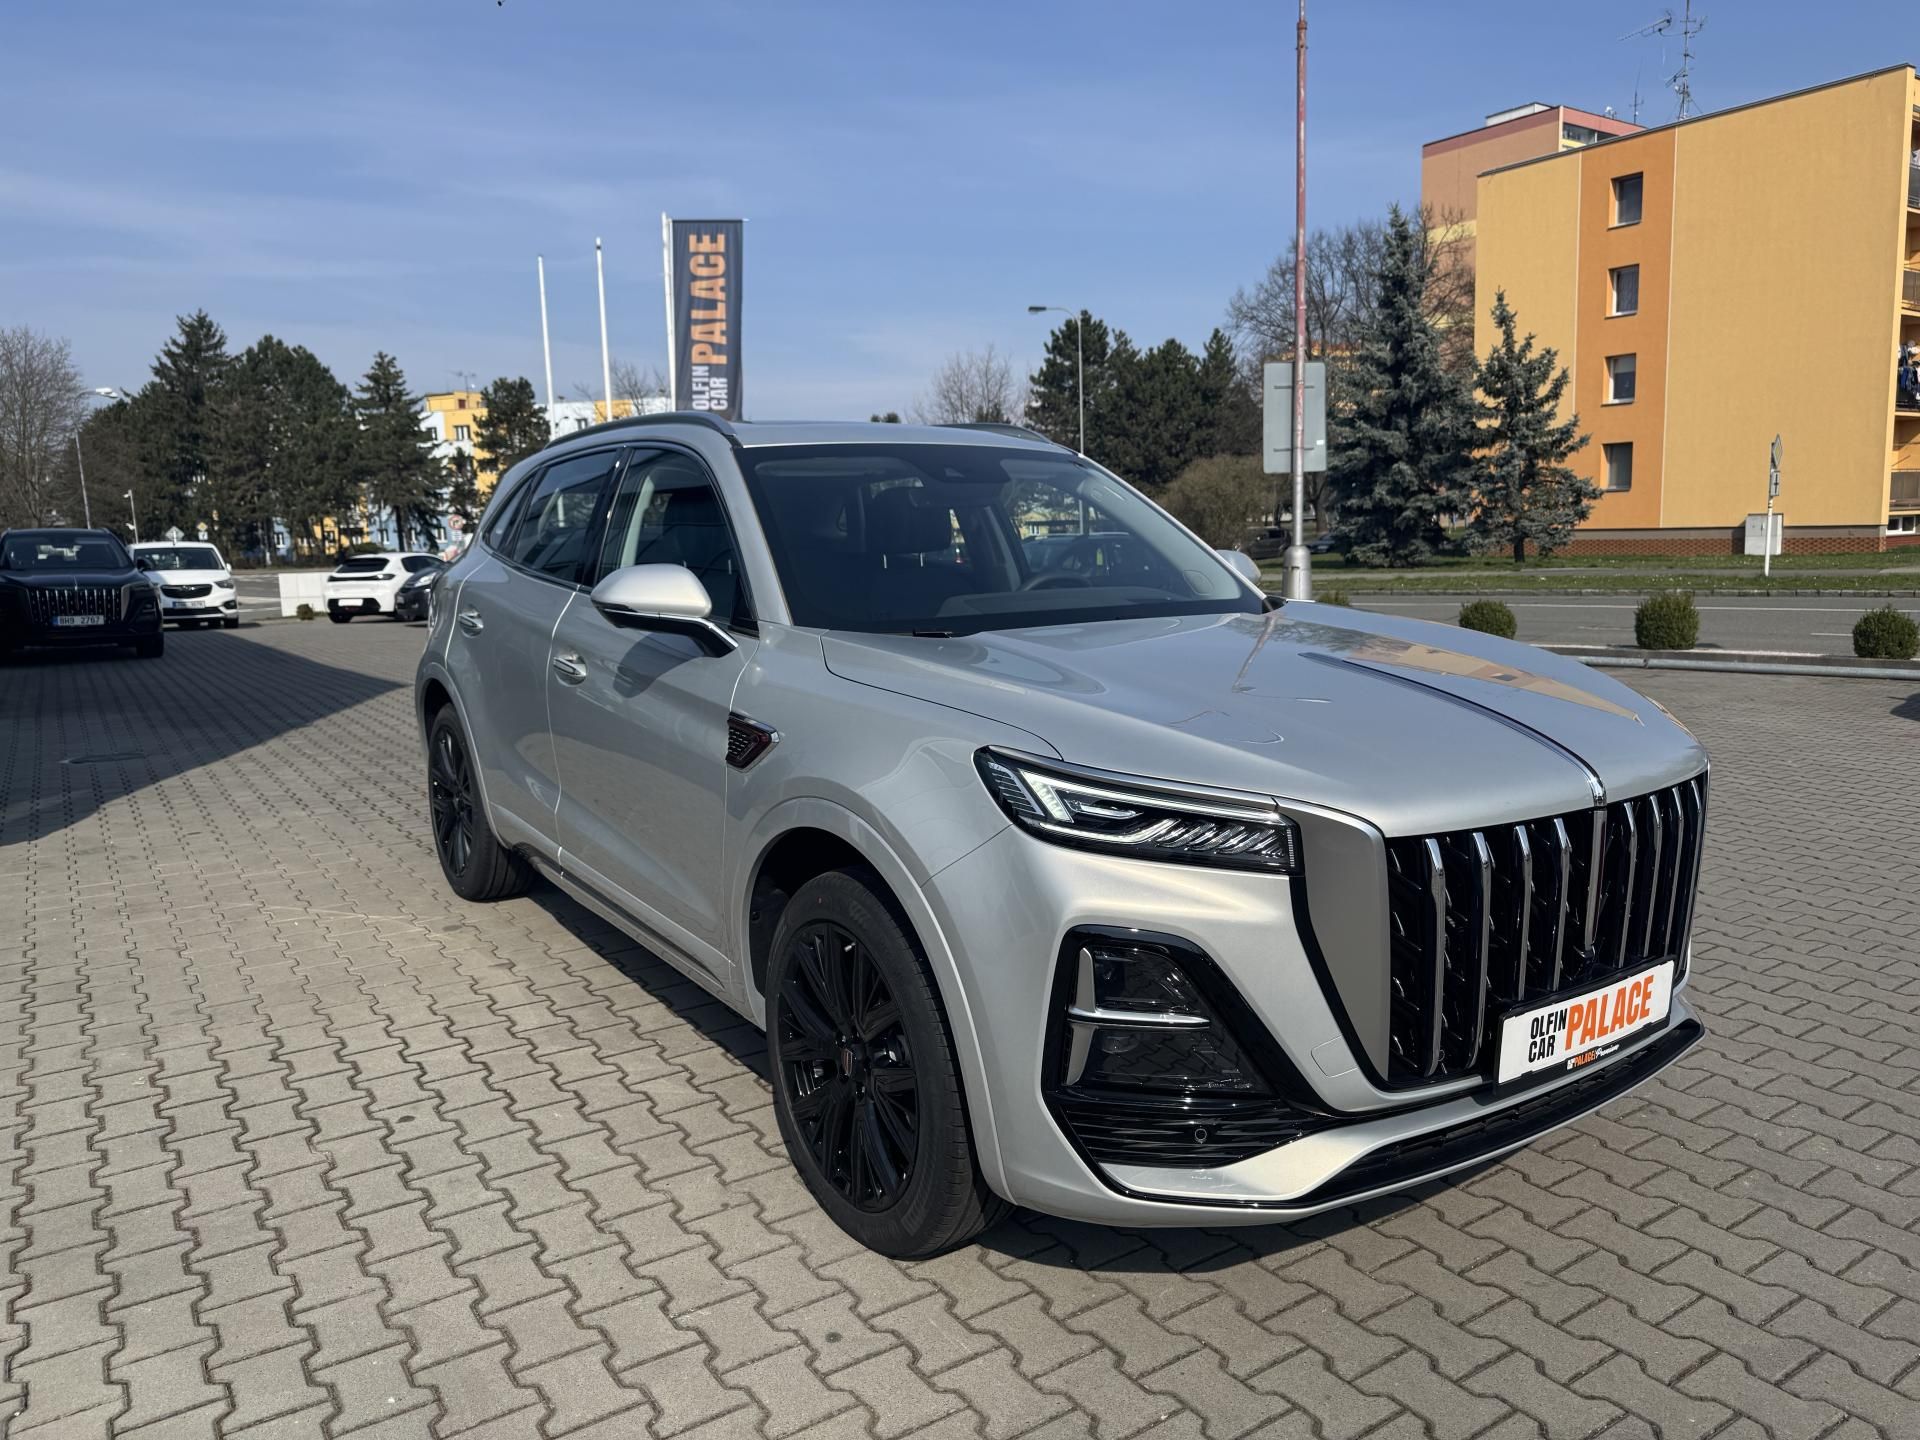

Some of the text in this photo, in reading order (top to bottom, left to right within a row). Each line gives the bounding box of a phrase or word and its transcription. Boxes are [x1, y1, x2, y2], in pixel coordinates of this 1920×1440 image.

[689, 233, 728, 365] PALACE
[691, 365, 709, 411] OLFIN
[710, 377, 728, 411] CAR
[1530, 1008, 1568, 1040] OLFIN
[1565, 974, 1654, 1052] PALACE
[1528, 1033, 1556, 1063] CAR
